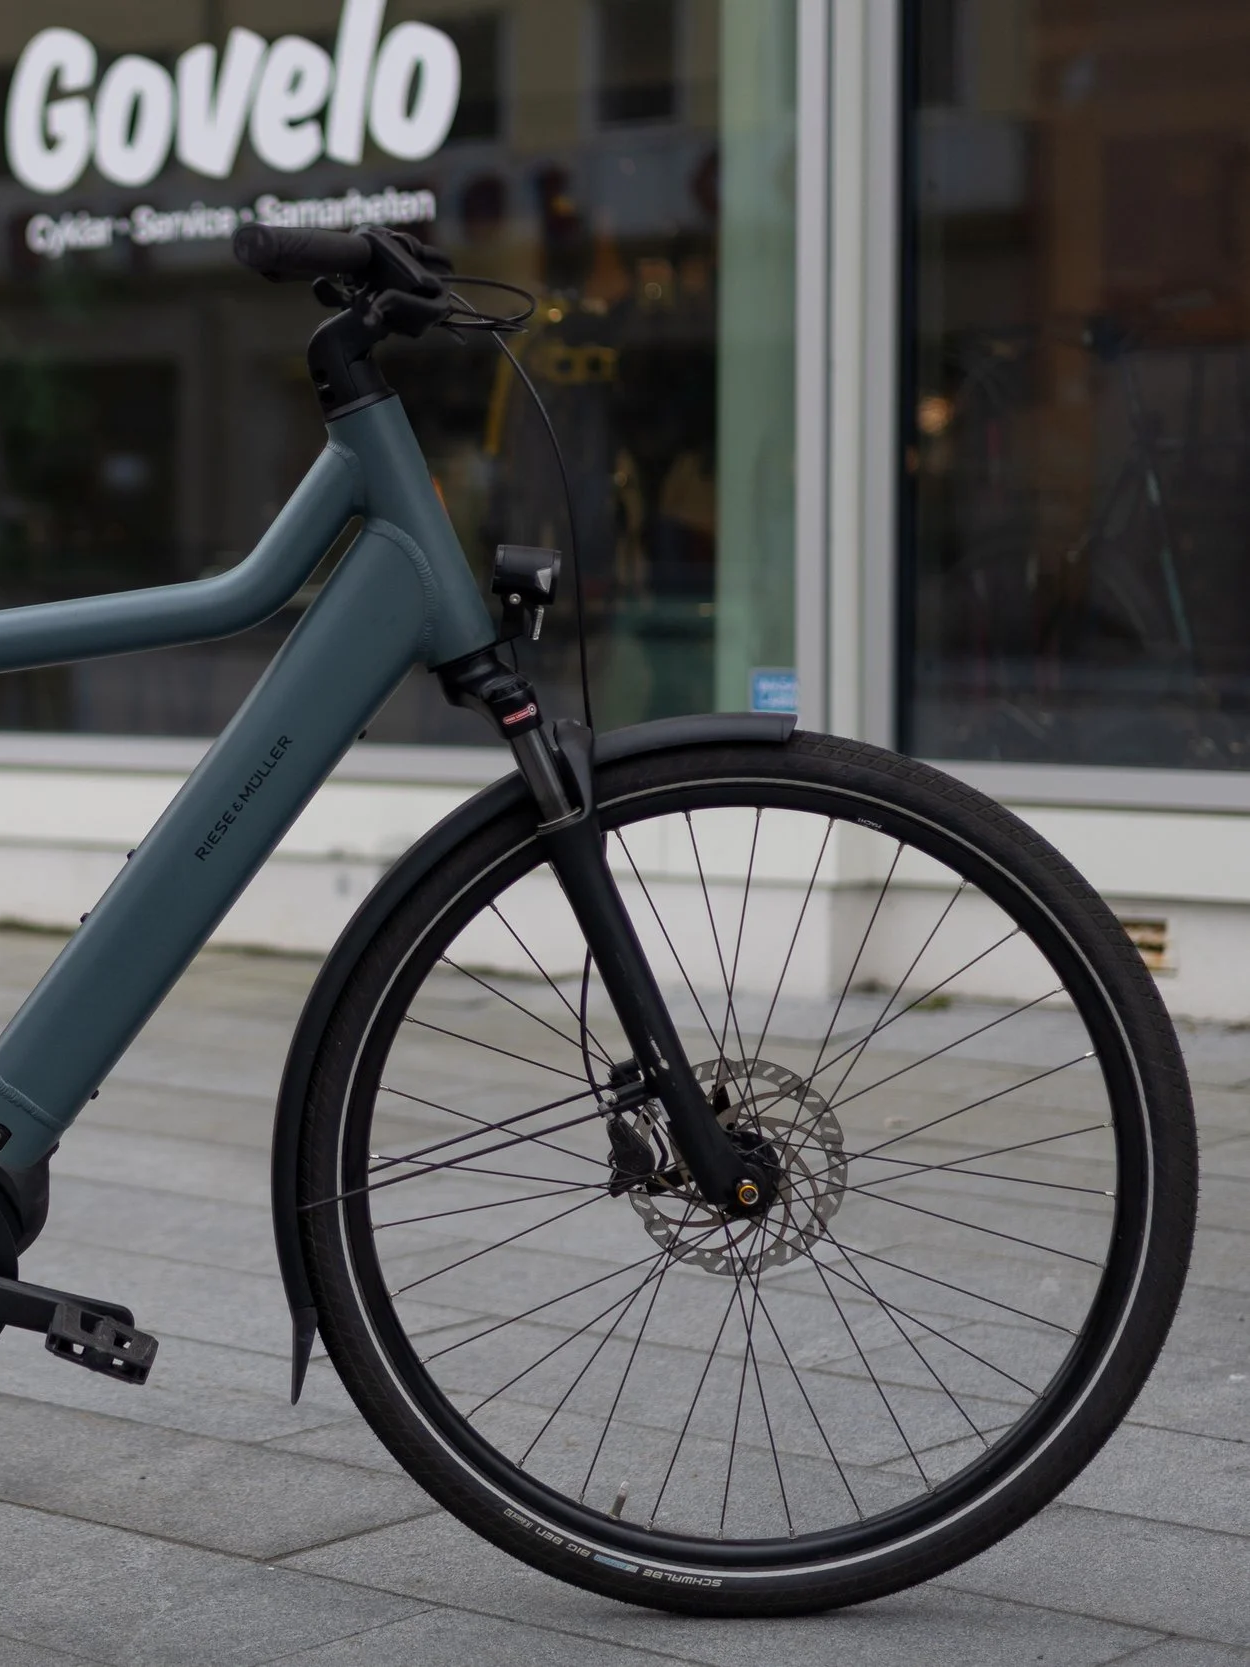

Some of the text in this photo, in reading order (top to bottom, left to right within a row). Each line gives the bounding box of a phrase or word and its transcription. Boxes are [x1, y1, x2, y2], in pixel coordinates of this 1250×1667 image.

[26, 212, 113, 258] Cyklar
[130, 202, 238, 244] Service
[194, 811, 237, 861] RIESE
[238, 735, 293, 803] MÜLLER
[535, 1526, 723, 1587] SCHWALBE BIG BEN
